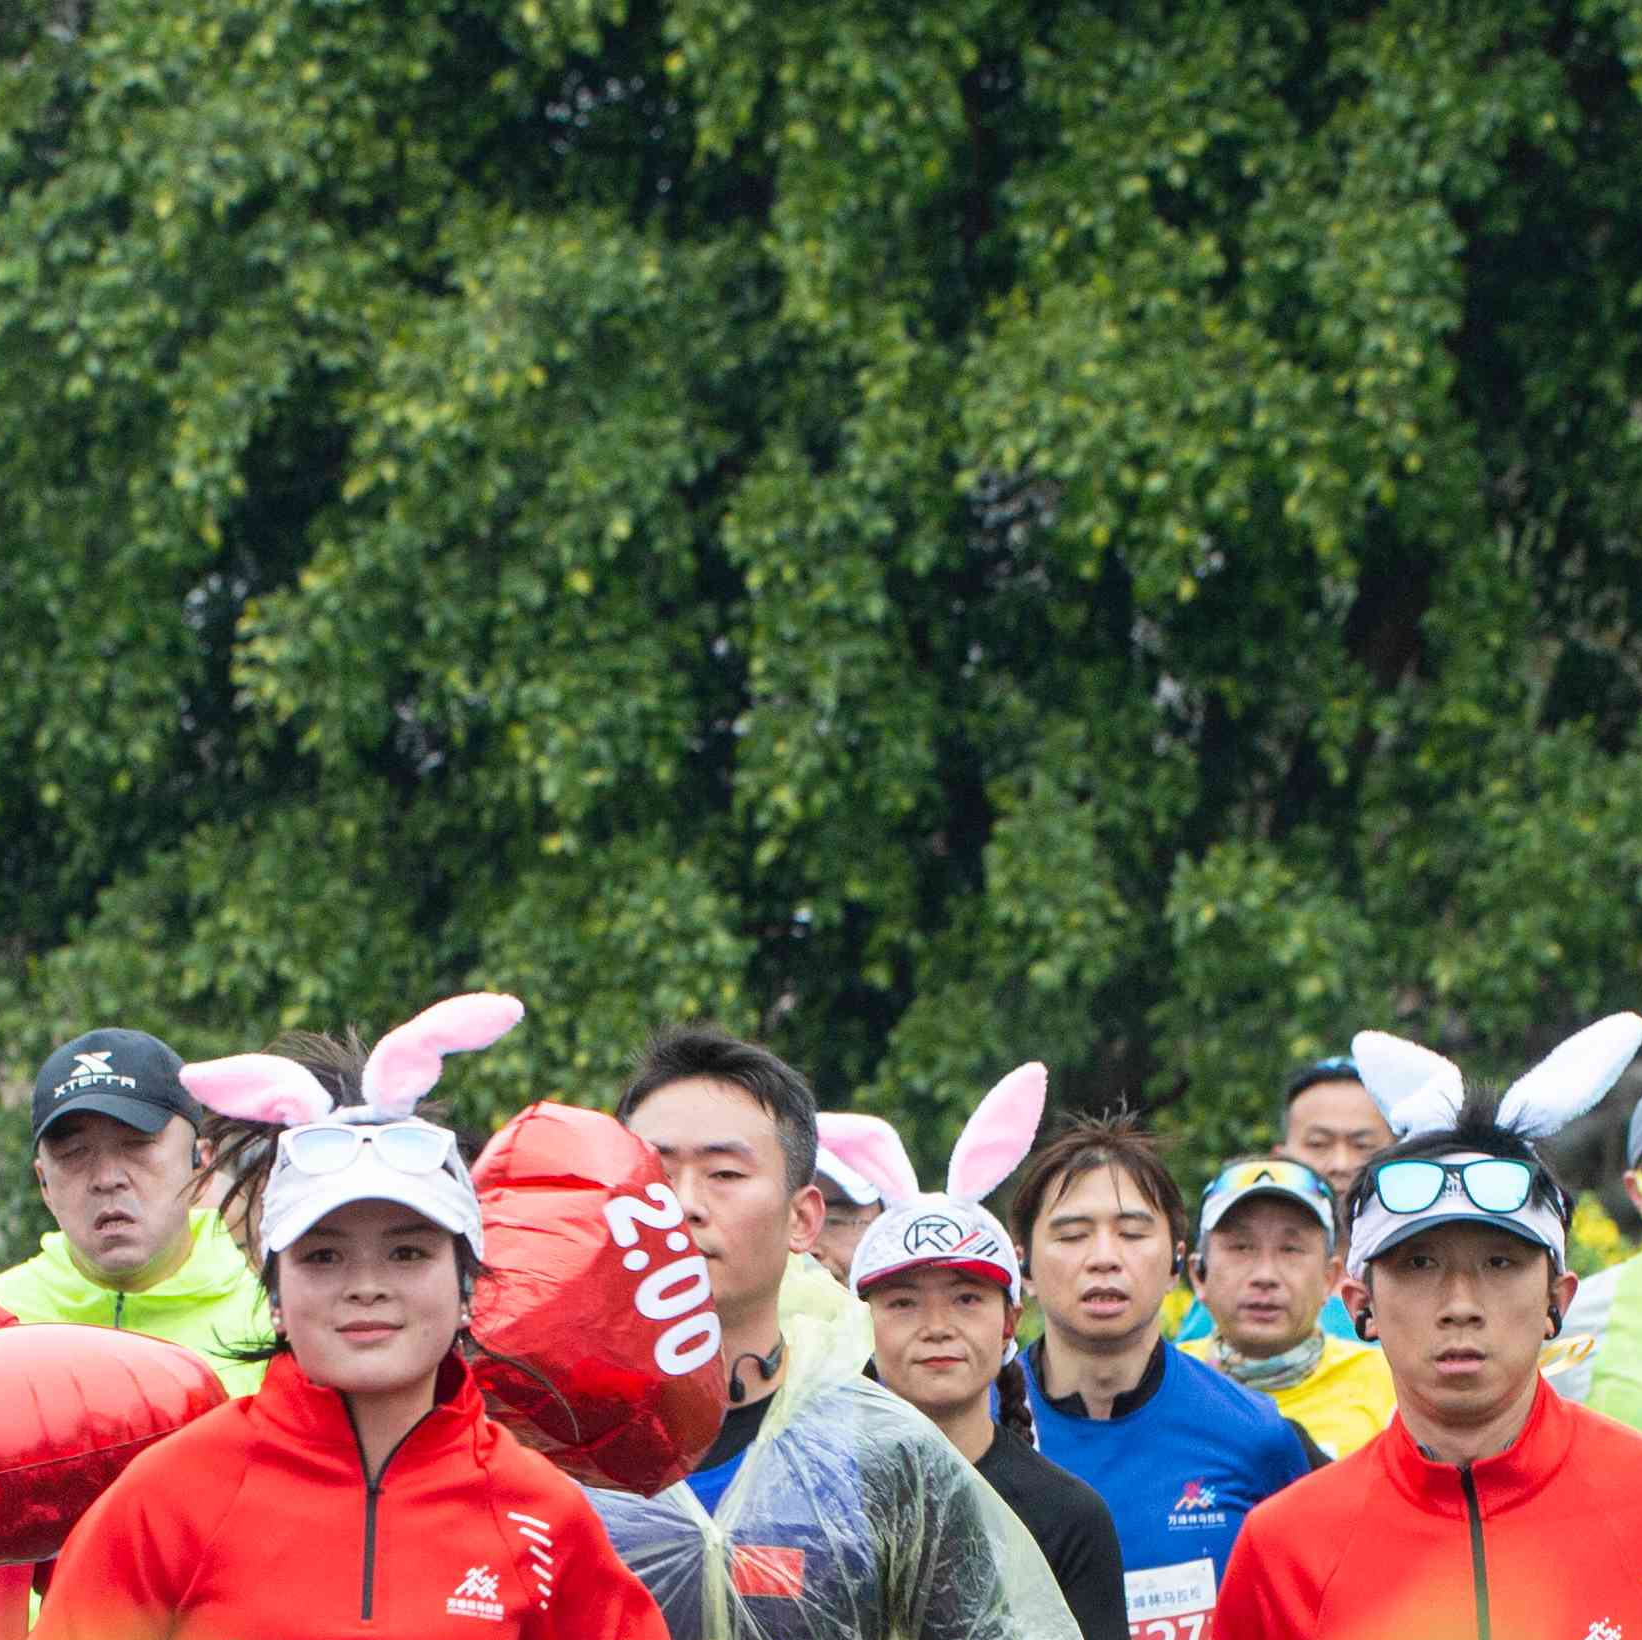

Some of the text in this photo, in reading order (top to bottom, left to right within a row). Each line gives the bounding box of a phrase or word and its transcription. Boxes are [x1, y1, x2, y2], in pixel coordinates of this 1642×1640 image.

[602, 1182, 722, 1376] 2:00
[1125, 1585, 1203, 1611] 峰林马拉松
